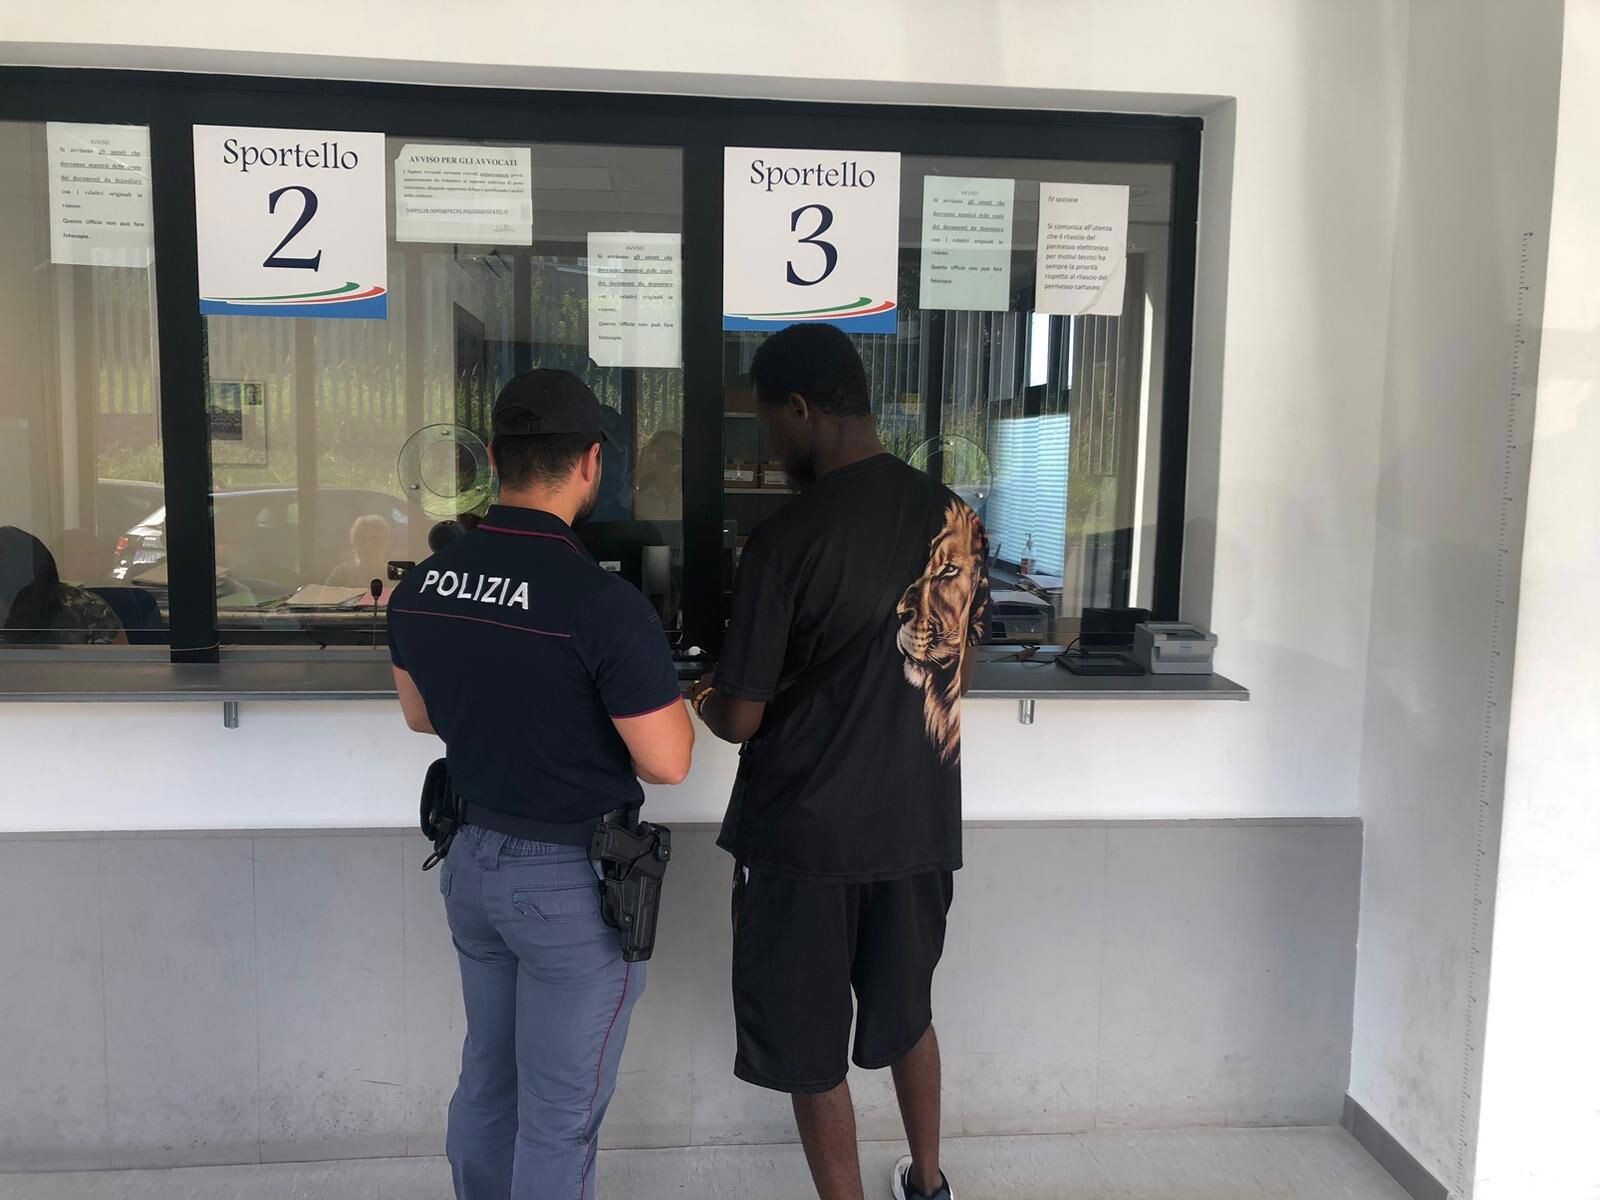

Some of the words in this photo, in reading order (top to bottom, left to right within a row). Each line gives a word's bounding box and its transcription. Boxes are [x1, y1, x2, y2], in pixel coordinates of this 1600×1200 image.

[223, 138, 358, 172] Sportello
[410, 156, 440, 164] AVVISO
[441, 156, 457, 164] PER
[476, 157, 517, 166] AVVOCATI
[750, 160, 875, 191] Sportello
[263, 185, 322, 272] 2
[787, 204, 837, 286] 3
[419, 570, 529, 610] POLIZIA
